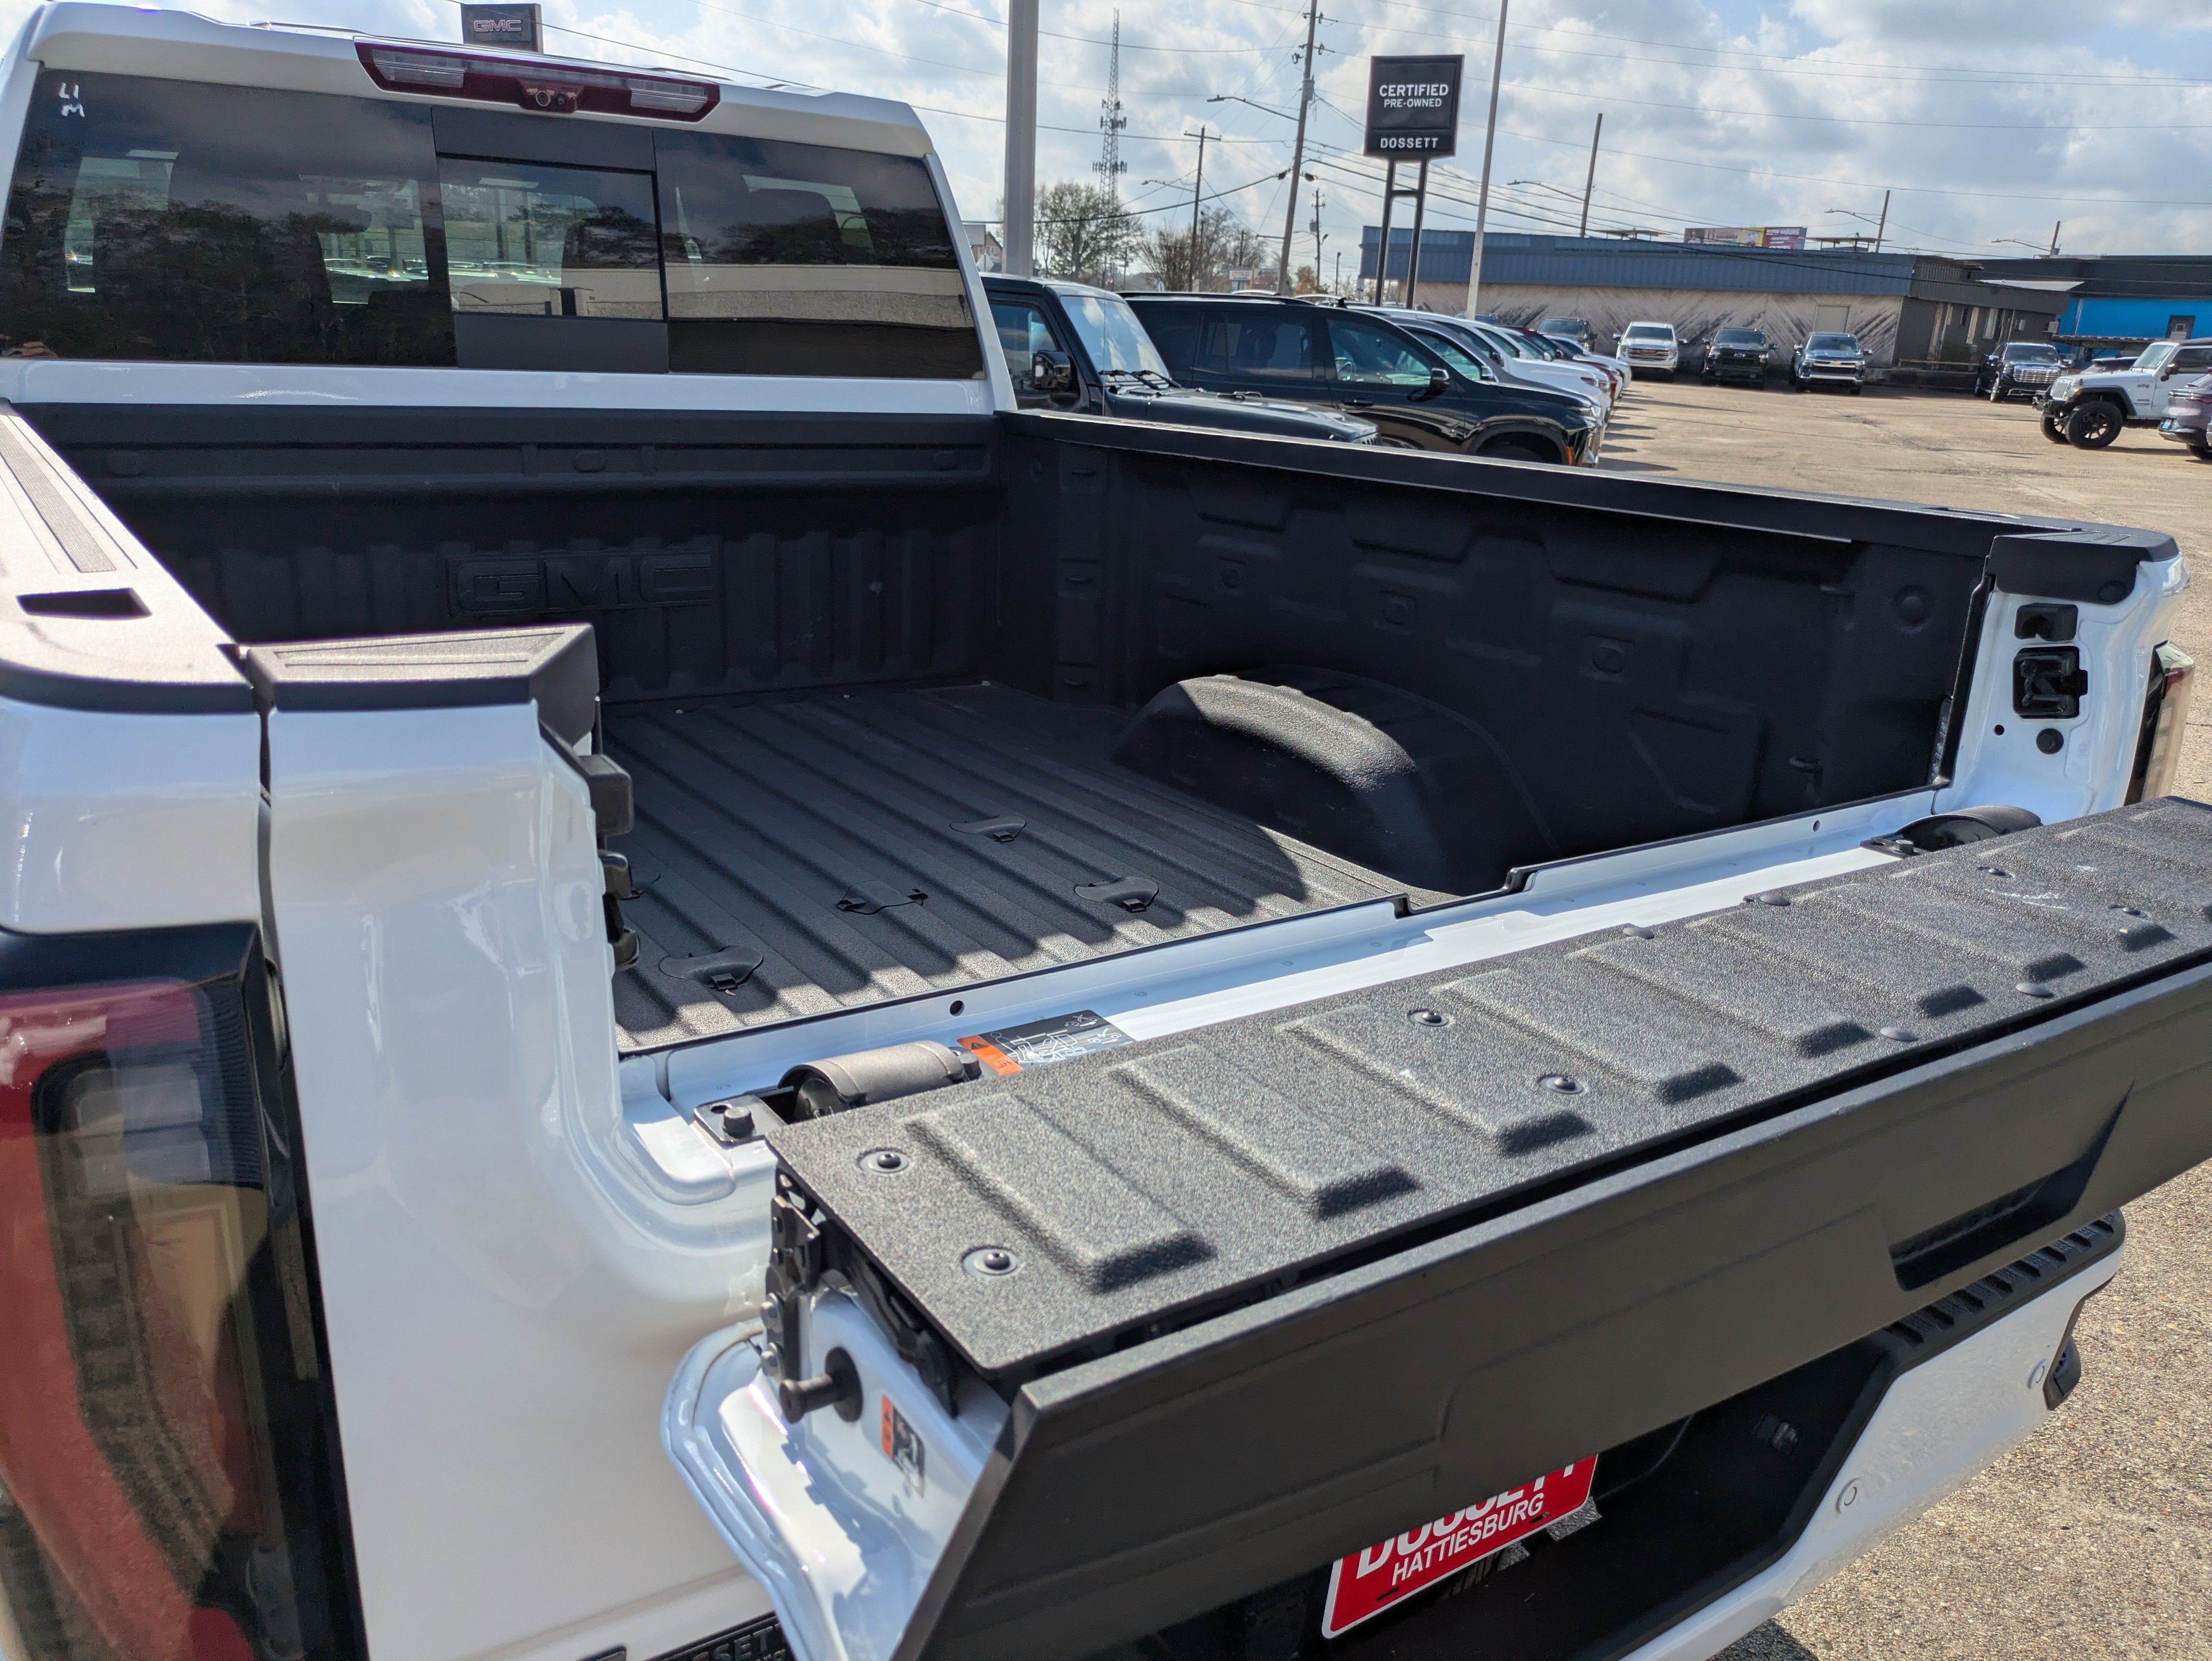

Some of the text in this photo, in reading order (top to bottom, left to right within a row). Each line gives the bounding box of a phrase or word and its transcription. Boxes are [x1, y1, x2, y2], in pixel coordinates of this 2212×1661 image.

[474, 20, 522, 32] GMC
[1379, 83, 1449, 97] CERTIFIED
[1383, 98, 1442, 108] PRE-OWNED
[1380, 137, 1439, 149] DOSSETT
[455, 554, 713, 615] GMC
[1392, 1493, 1545, 1586] HATTIESBURG
